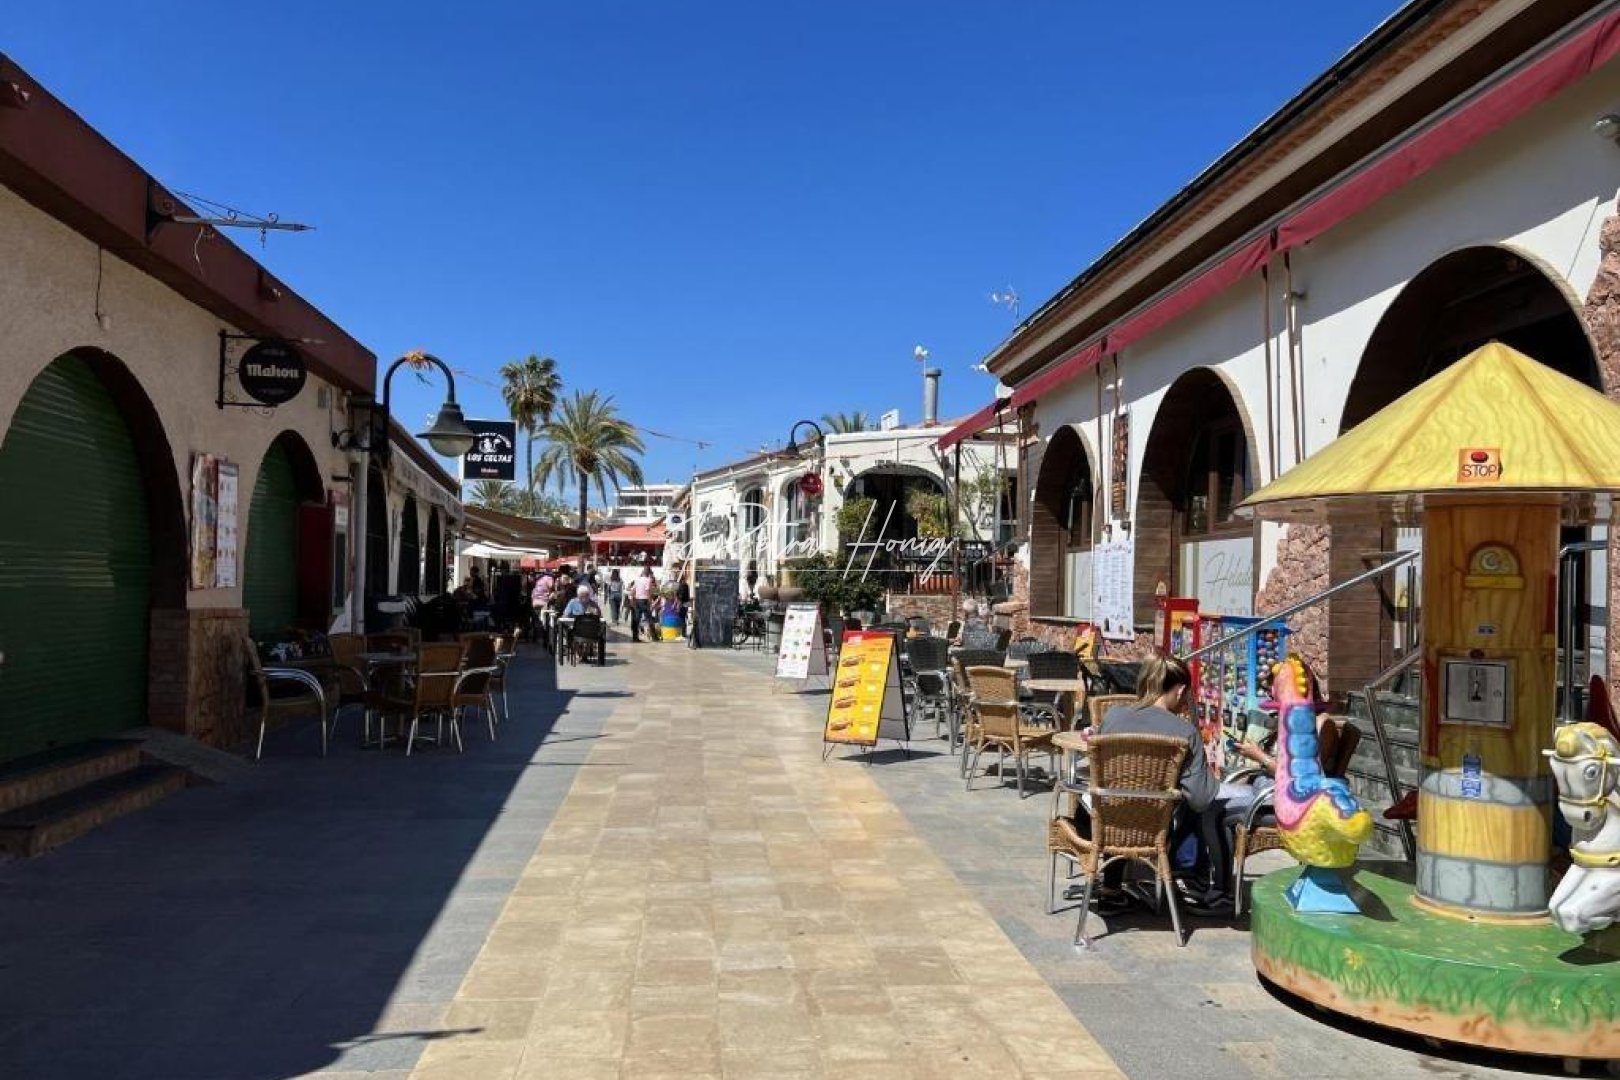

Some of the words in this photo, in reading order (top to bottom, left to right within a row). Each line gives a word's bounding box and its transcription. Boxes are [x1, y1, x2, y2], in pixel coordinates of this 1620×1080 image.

[467, 453, 482, 462] LOS
[483, 454, 512, 463] CELTAS
[1461, 464, 1497, 478] STOP
